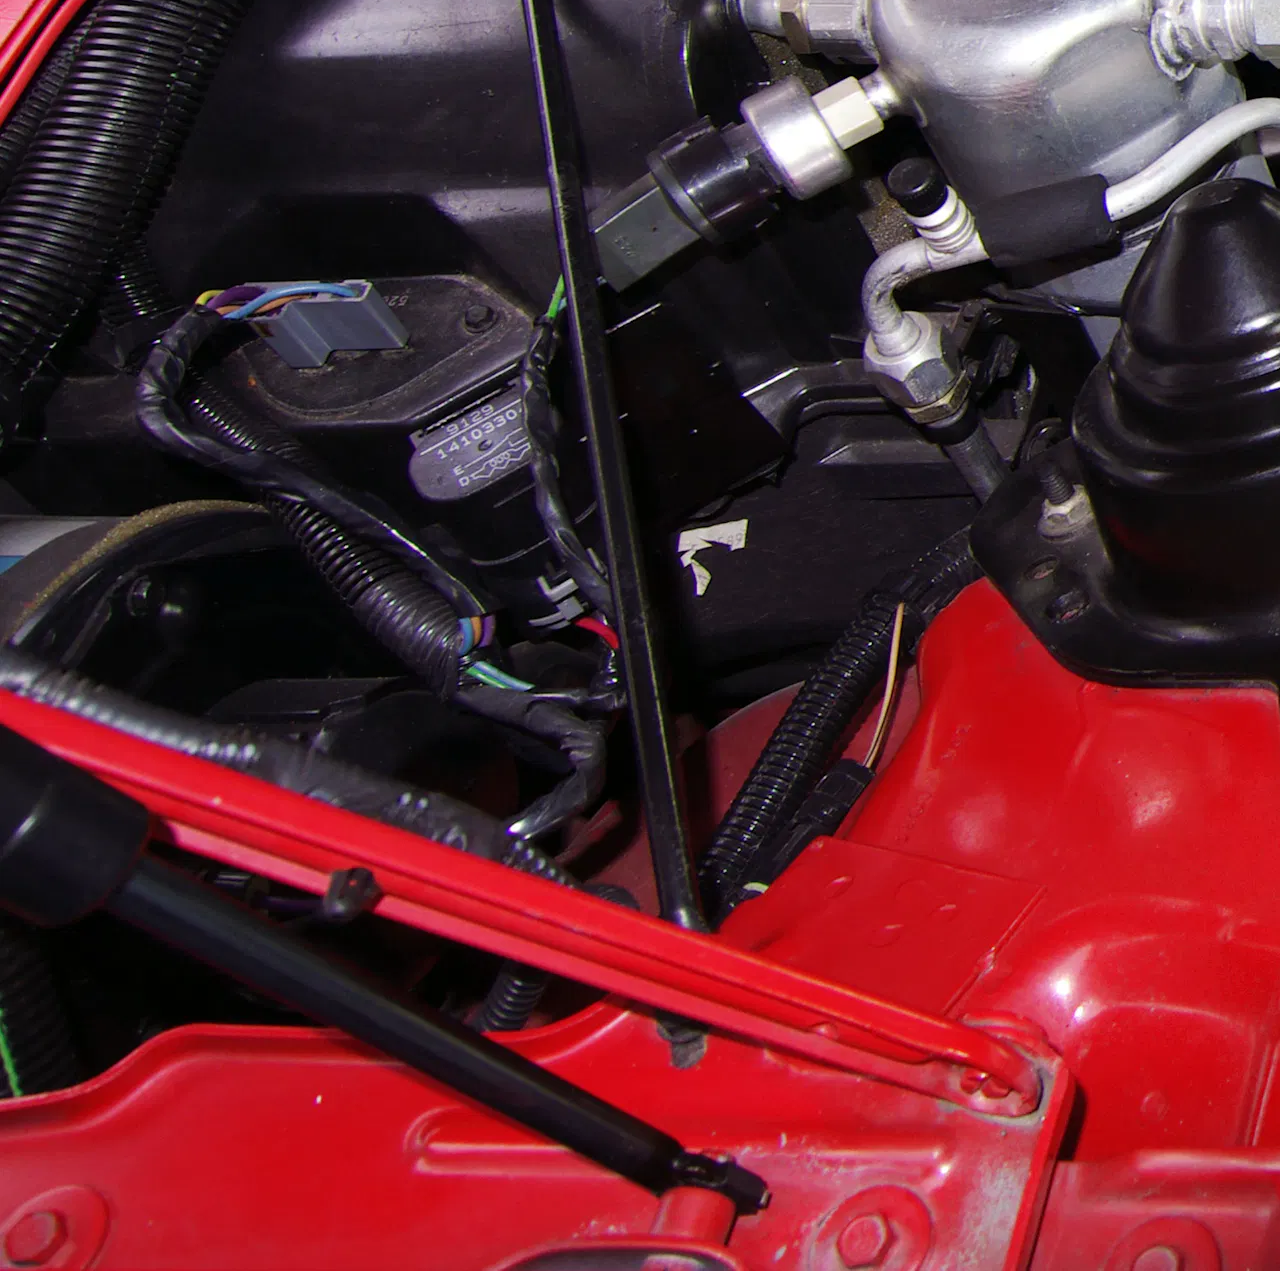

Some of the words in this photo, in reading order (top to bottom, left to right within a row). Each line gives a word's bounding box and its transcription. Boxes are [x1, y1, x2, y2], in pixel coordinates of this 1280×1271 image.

[445, 402, 494, 435] 9129
[436, 407, 521, 458] 1410330
[452, 464, 464, 476] E
[458, 475, 470, 487] D
